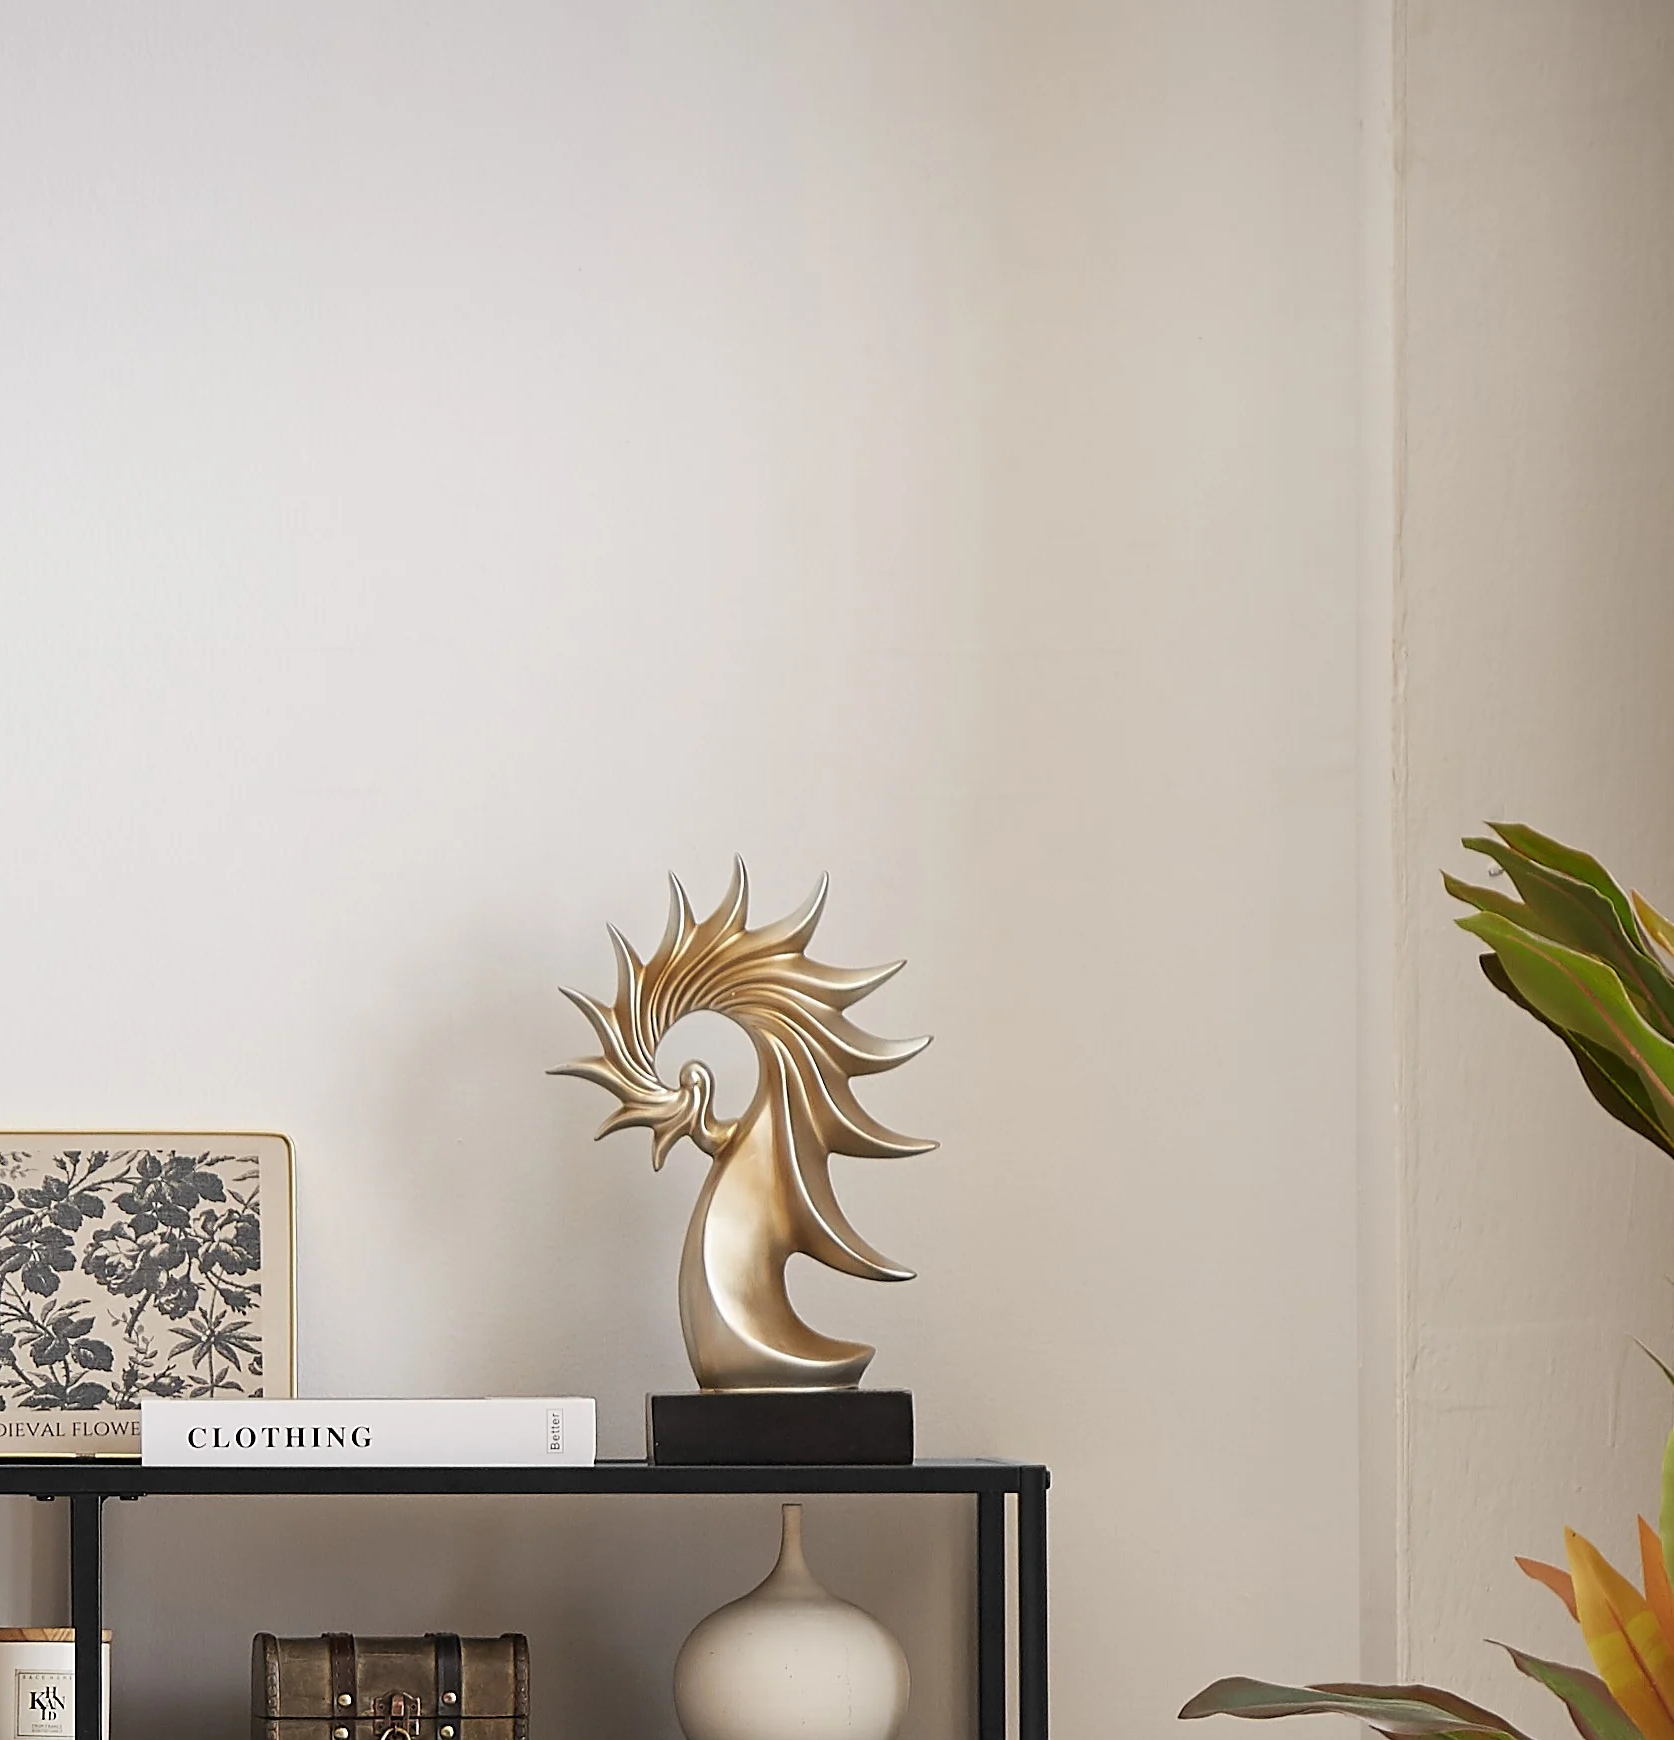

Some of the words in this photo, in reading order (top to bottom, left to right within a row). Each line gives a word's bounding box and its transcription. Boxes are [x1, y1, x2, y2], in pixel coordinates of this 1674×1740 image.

[72, 1421, 141, 1437] FLOWE
[187, 1426, 374, 1448] CLOTHING
[550, 1412, 561, 1450] Better
